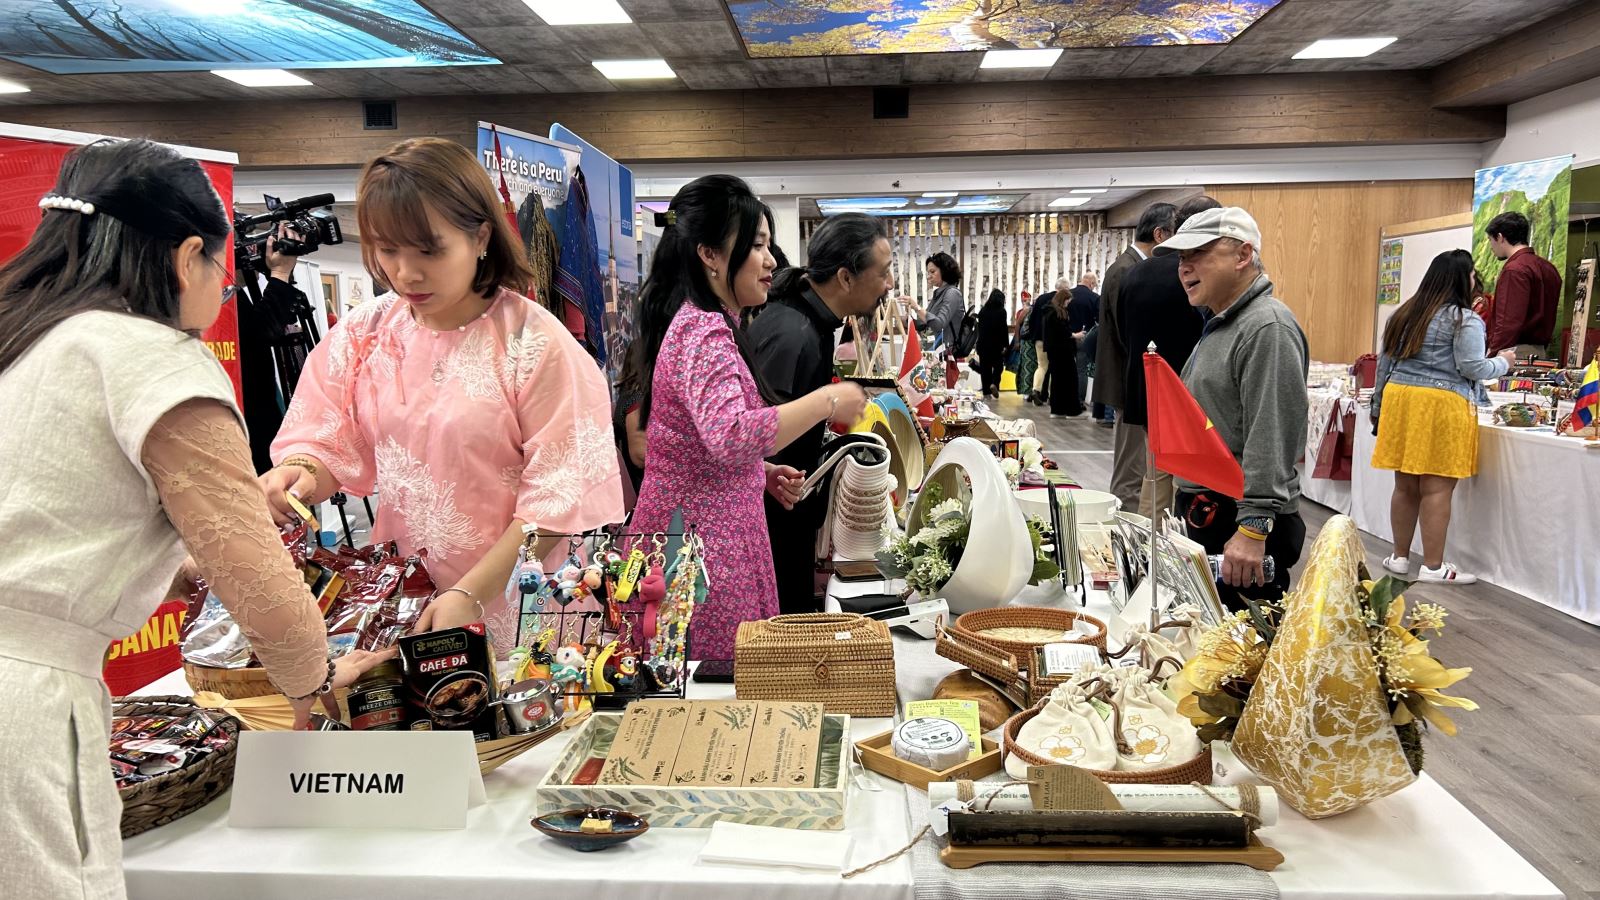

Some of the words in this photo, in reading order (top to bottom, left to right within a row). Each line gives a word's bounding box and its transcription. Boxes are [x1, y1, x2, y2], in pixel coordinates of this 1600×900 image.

[484, 150, 518, 173] There
[519, 156, 529, 176] is
[530, 164, 536, 178] a
[538, 162, 562, 182] Peru
[520, 182, 532, 193] and
[533, 185, 565, 200] everyone
[359, 701, 382, 712] FREEZE
[290, 772, 404, 794] VIETNAM
